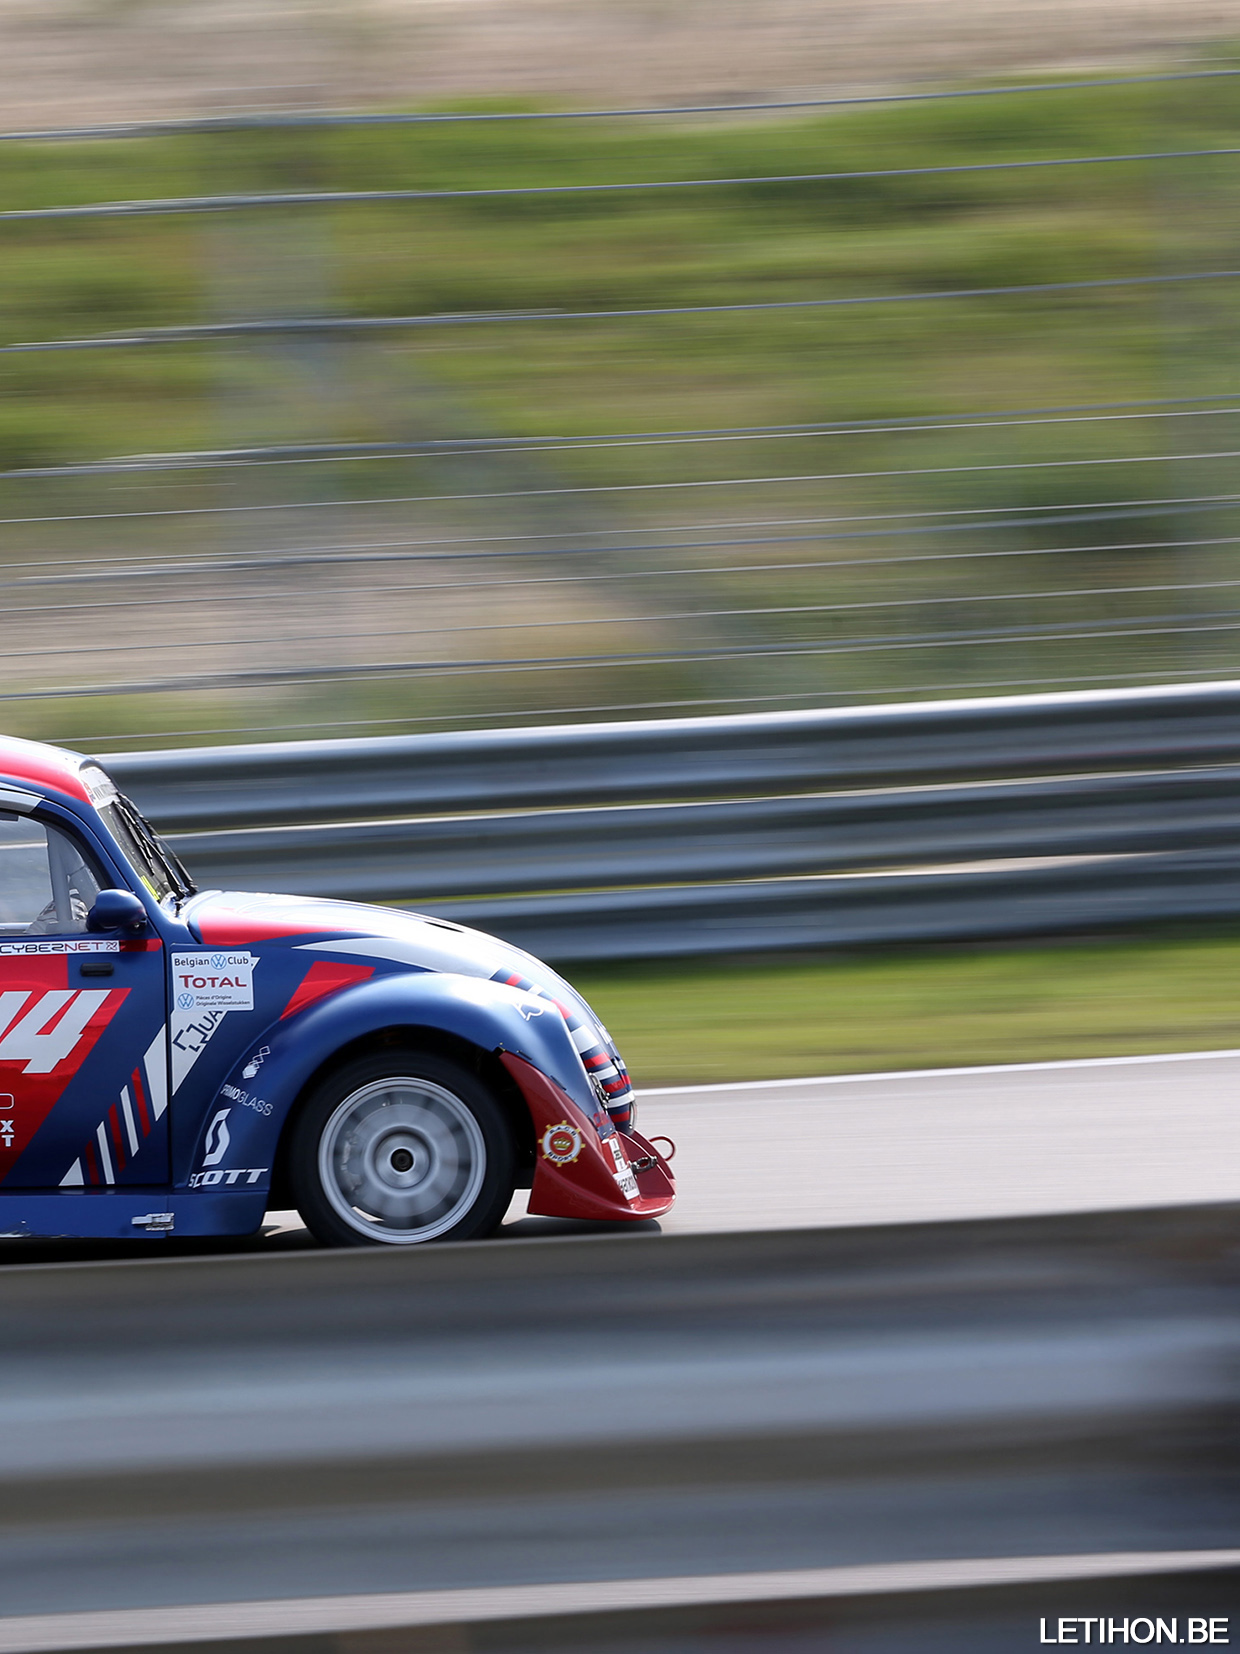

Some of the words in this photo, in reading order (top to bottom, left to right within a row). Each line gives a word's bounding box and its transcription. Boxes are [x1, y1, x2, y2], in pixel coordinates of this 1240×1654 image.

[174, 957, 210, 968] Belgian
[227, 956, 249, 965] Club
[179, 975, 247, 988] TOTAL
[188, 1168, 268, 1189] SCOTT
